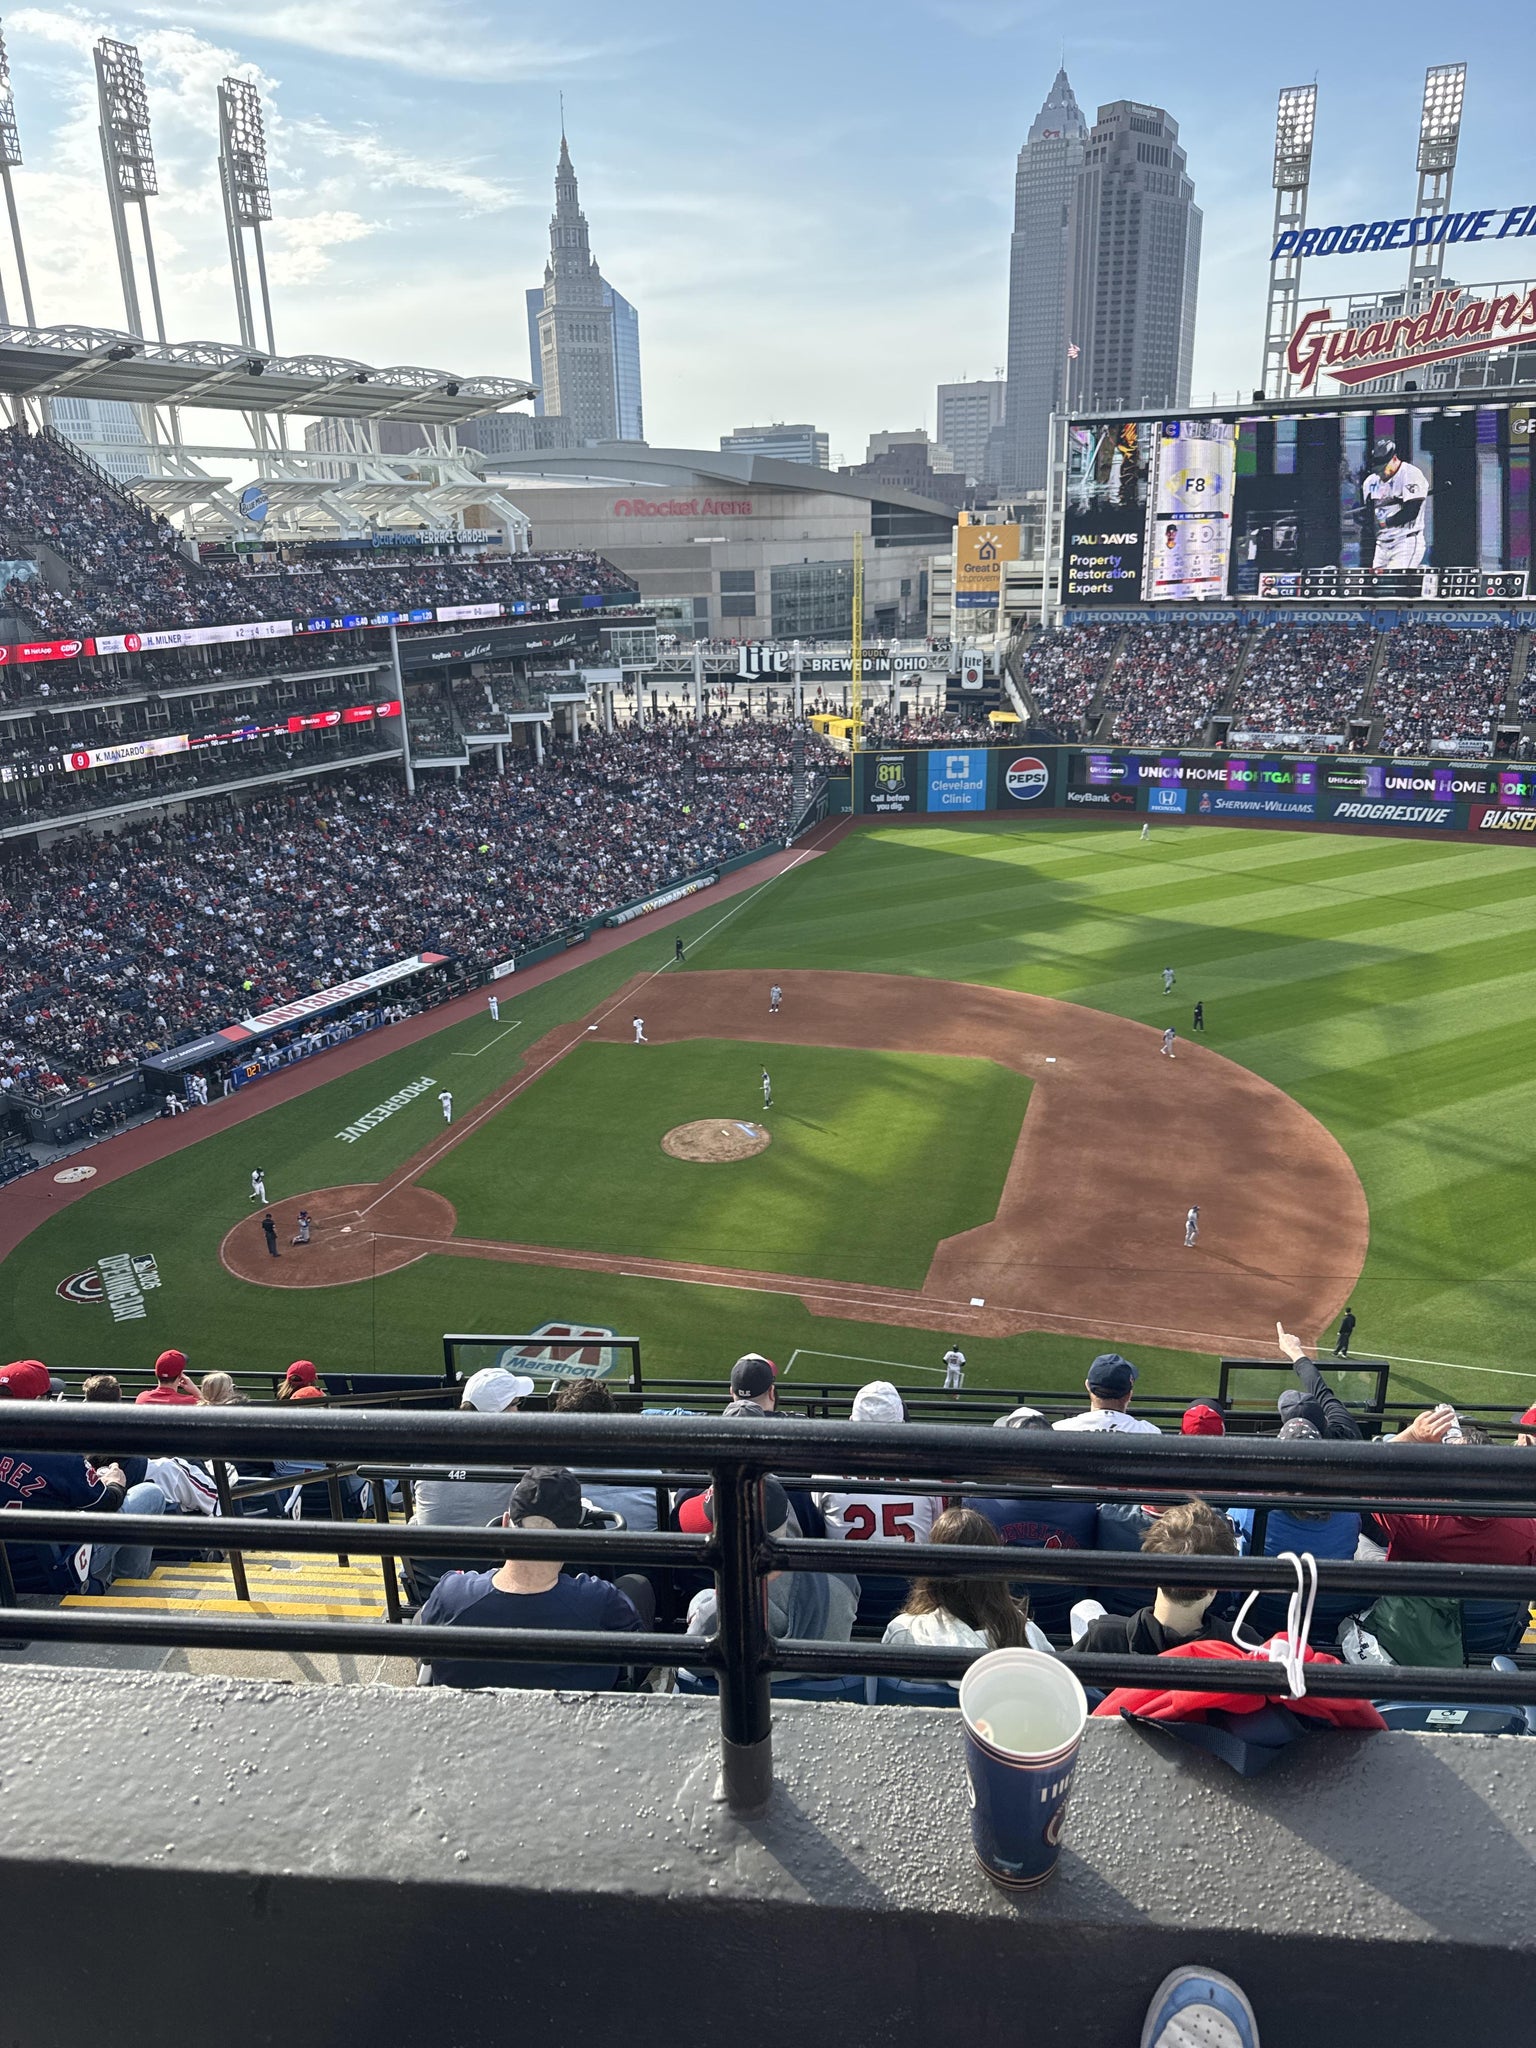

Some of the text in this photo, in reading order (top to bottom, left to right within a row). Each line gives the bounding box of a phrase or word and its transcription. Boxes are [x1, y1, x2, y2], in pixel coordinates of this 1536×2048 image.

[1270, 204, 1536, 261] PROGRESSIVE FI
[1287, 288, 1536, 393] Guardians
[1185, 478, 1206, 492] F8
[634, 498, 752, 517] Rocket Arena
[420, 530, 456, 544] TERRACE
[456, 530, 489, 543] GARDEN
[1101, 533, 1138, 545] DAVIS
[1069, 554, 1122, 568] Property
[964, 563, 990, 573] Great
[1069, 568, 1136, 579] Restoration
[1494, 577, 1502, 585] 0
[1514, 577, 1522, 585] 0
[1068, 582, 1114, 595] Experts
[1087, 612, 1150, 622] HONDA
[1171, 611, 1238, 622] HONDA
[1292, 612, 1365, 622] HONDA
[1426, 612, 1503, 623] HONDA
[128, 638, 137, 649] 41
[155, 634, 182, 645] MILNER
[61, 644, 77, 652] CDW
[736, 646, 790, 680] Lite
[812, 657, 928, 671] BREWED IN OHIO
[964, 657, 982, 669] Lite
[77, 745, 145, 766] 9 K. MANZARDO
[39, 762, 62, 773] 0 0 1
[1448, 761, 1489, 770] PROGRESSIVE
[879, 764, 902, 782] 811
[1008, 773, 1046, 784] PEPSI
[1139, 766, 1184, 779] UNION
[1186, 768, 1228, 780] HOME
[932, 780, 984, 791] Cleveland
[1385, 777, 1436, 790] UNION
[1440, 780, 1486, 793] HOME
[870, 794, 910, 802] Call before
[942, 793, 972, 804] Clinic
[1067, 792, 1110, 803] KeyBank
[876, 802, 905, 812] you dig.
[1333, 803, 1450, 823] PROGRESSIVE
[1480, 810, 1536, 831] BLASTE
[255, 981, 371, 1026] CLEVELAND
[334, 1076, 438, 1143] PROGRESSIVE
[97, 1253, 147, 1322] OPENING DAY
[506, 1357, 597, 1377] Marathon
[448, 1470, 466, 1480] 442
[843, 1502, 916, 1542] 25
